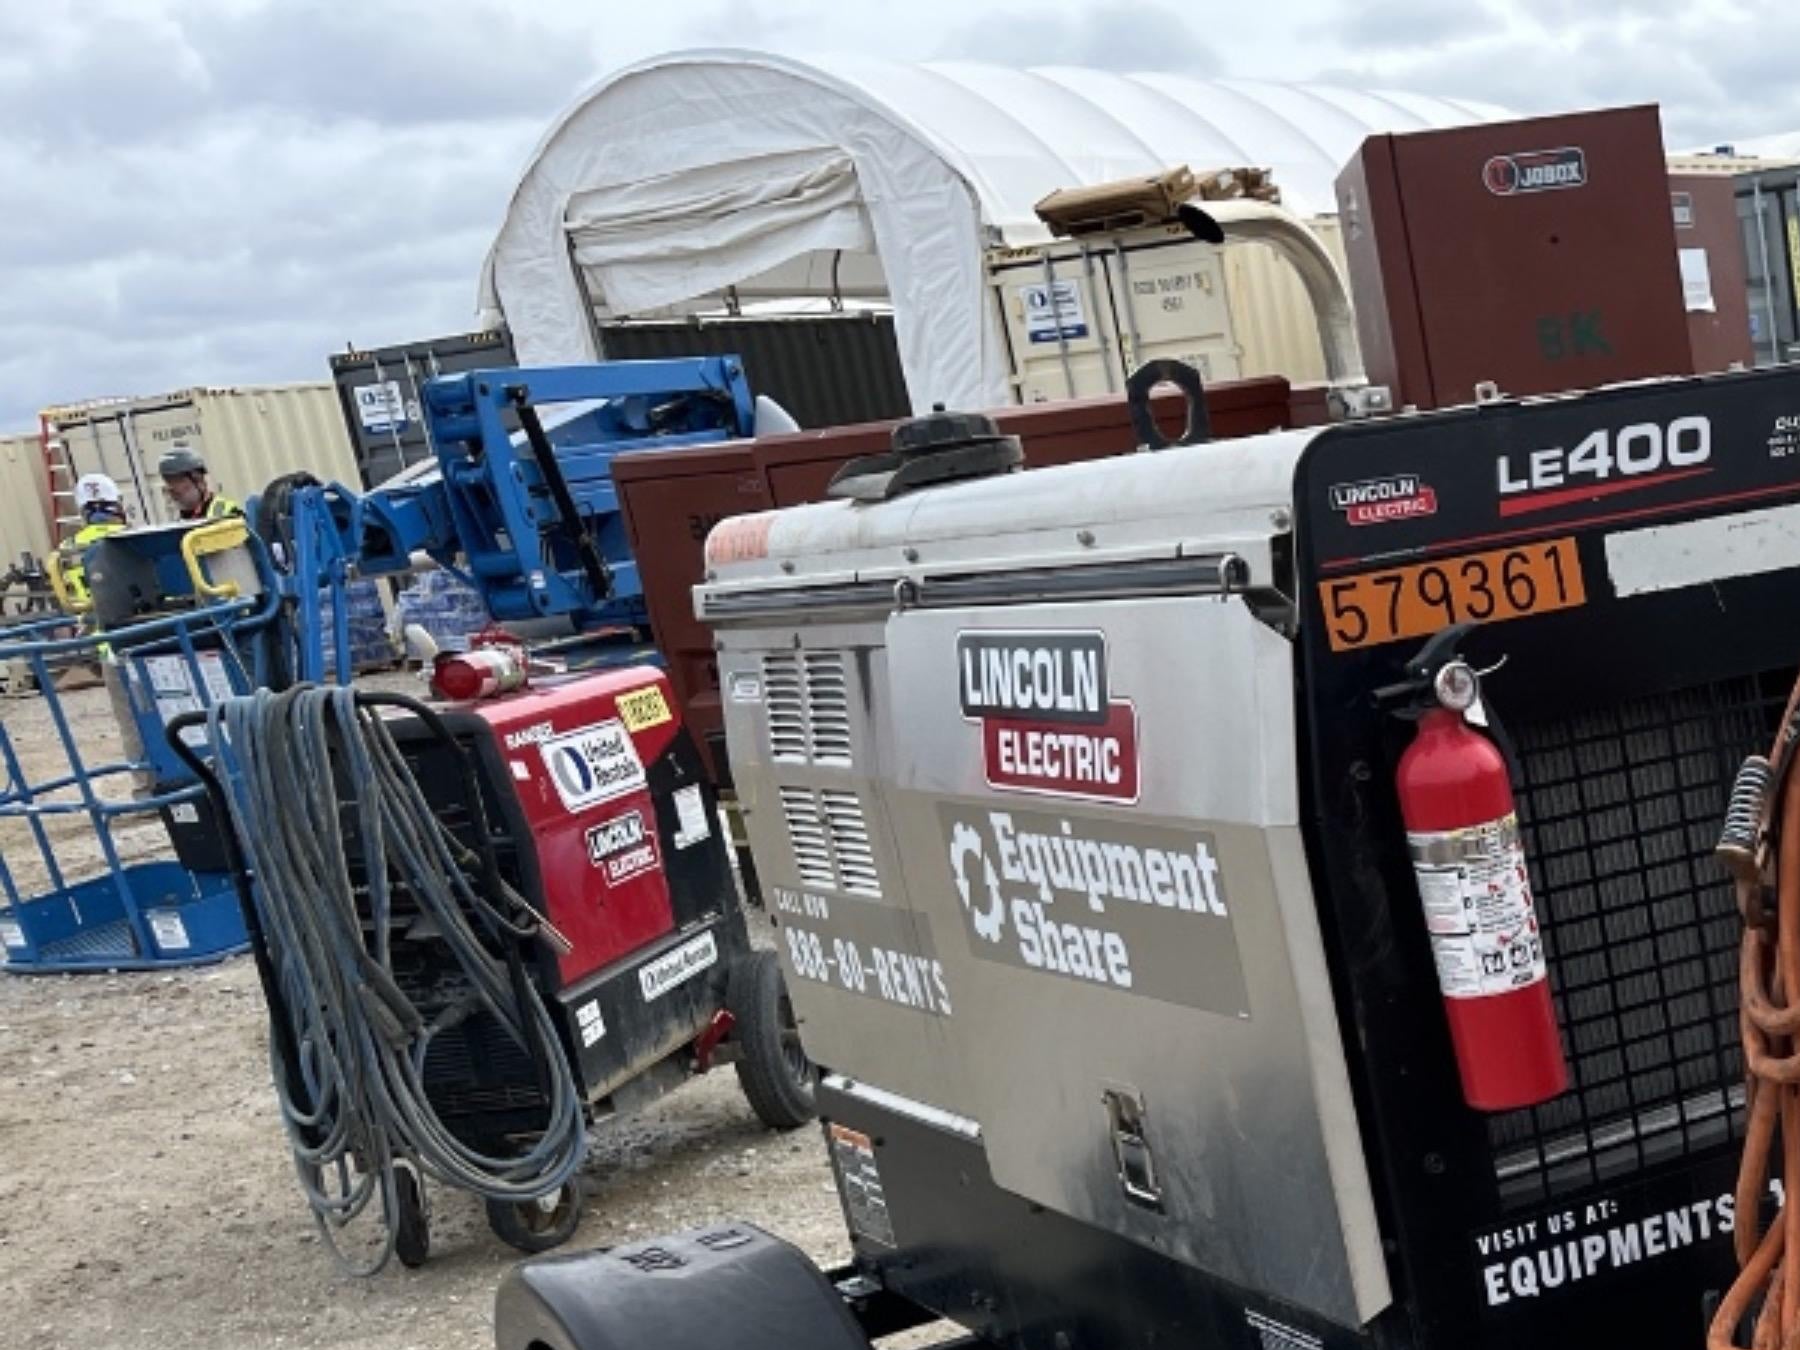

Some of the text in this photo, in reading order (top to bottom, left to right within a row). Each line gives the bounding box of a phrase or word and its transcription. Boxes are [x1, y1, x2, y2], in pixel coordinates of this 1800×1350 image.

[1520, 161, 1581, 187] JOBOX
[1536, 304, 1614, 364] BK
[1496, 415, 1712, 493] LE400
[1334, 479, 1415, 505] LINCOLN
[1358, 497, 1426, 520] ELECTRIC
[1330, 544, 1568, 644] 579361
[962, 648, 1099, 712] LINCOLN
[582, 730, 626, 763] United
[594, 756, 640, 787] Rentals
[998, 731, 1121, 784] ELECTRIC
[590, 817, 643, 859] LINCOLN
[989, 812, 1228, 917] Equipment
[773, 887, 802, 913] CALL
[1010, 898, 1133, 988] Share
[785, 926, 952, 1015] 888-80-RENTS
[1476, 1199, 1619, 1255] VISIT US AT:
